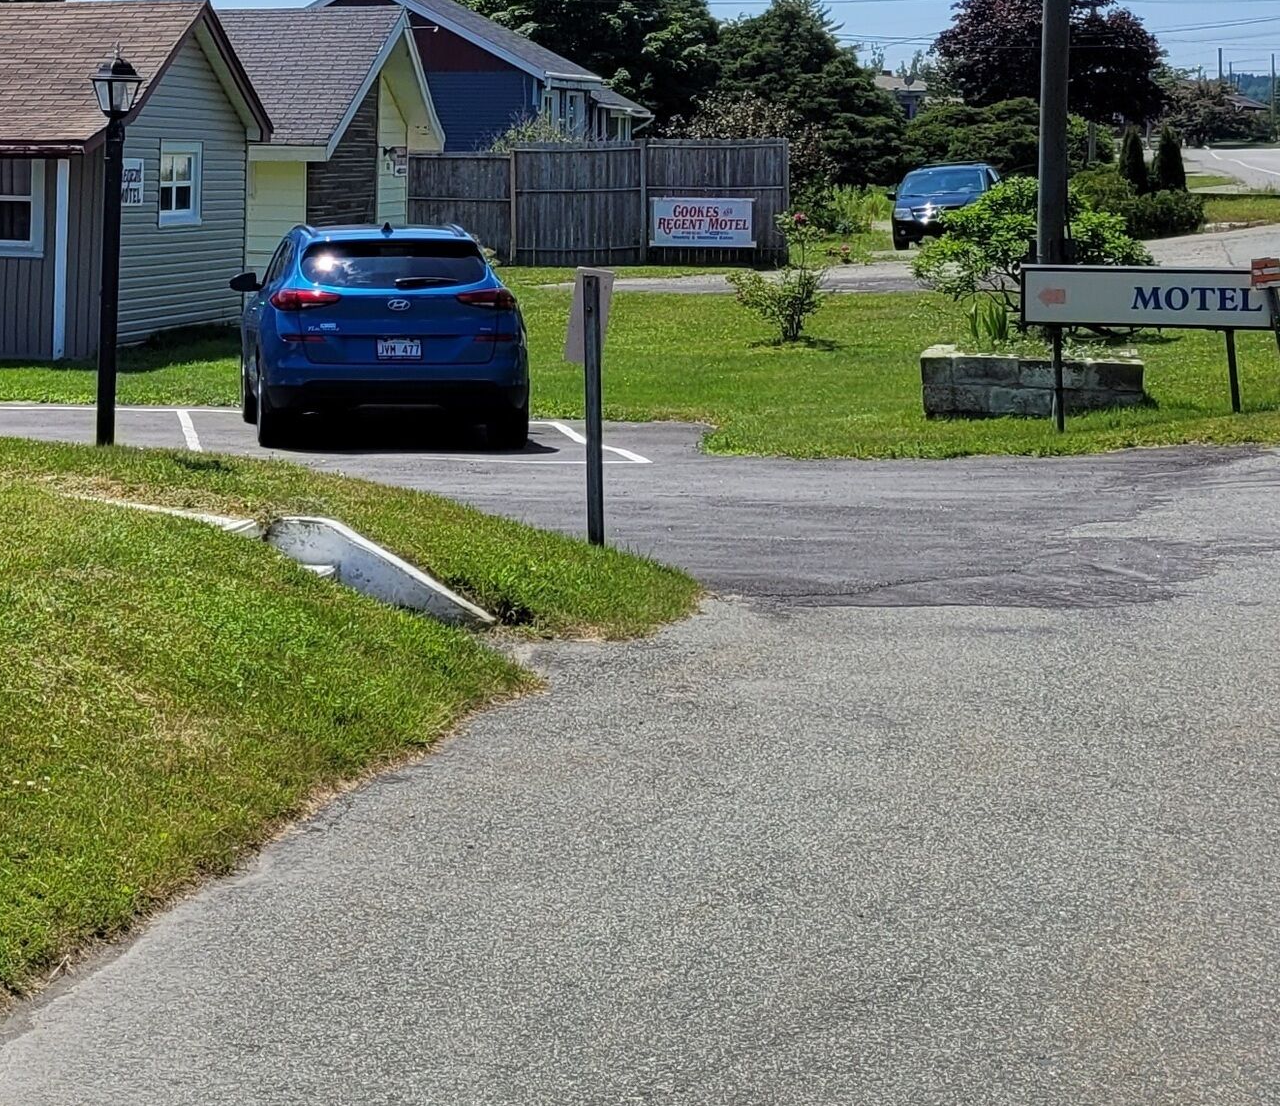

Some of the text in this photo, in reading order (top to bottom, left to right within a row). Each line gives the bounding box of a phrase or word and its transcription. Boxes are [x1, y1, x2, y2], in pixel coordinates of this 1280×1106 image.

[658, 217, 749, 235] REGENT MOTEL
[1131, 286, 1263, 312] MOTEL
[402, 344, 420, 355] 477
